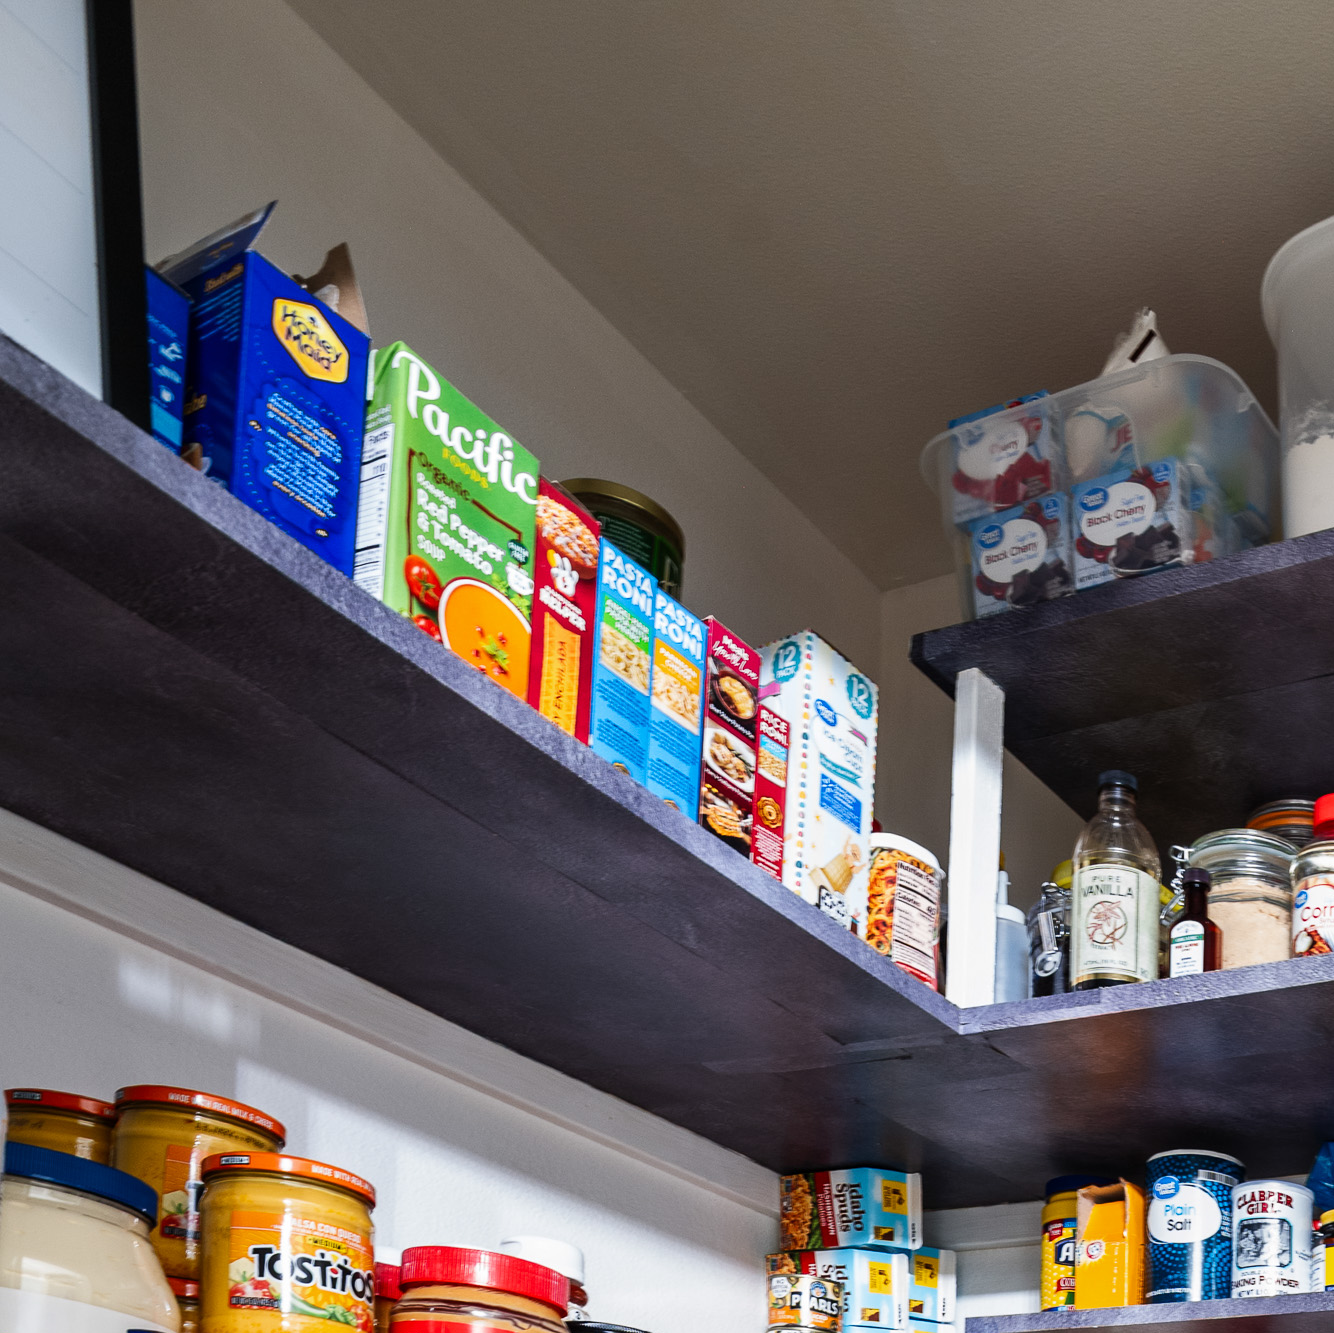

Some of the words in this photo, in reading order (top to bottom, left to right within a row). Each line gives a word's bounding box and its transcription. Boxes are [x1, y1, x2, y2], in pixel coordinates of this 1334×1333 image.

[281, 304, 342, 363] Honey
[391, 351, 538, 505] Pacific
[442, 448, 491, 490] FOODS
[416, 487, 449, 525] Red
[449, 513, 507, 563] Pepper
[602, 546, 653, 597] PASTA
[602, 564, 653, 617] RONI
[654, 612, 703, 661] RONI
[655, 593, 703, 642] PASTA
[759, 708, 788, 734] RICE
[1081, 886, 1135, 899] VANILLA
[834, 1182, 851, 1233] Spuds
[849, 1182, 865, 1232] Idaho
[1163, 1202, 1197, 1218] Plain
[1166, 1217, 1192, 1232] Salt
[250, 1245, 375, 1301] TOSTITOS
